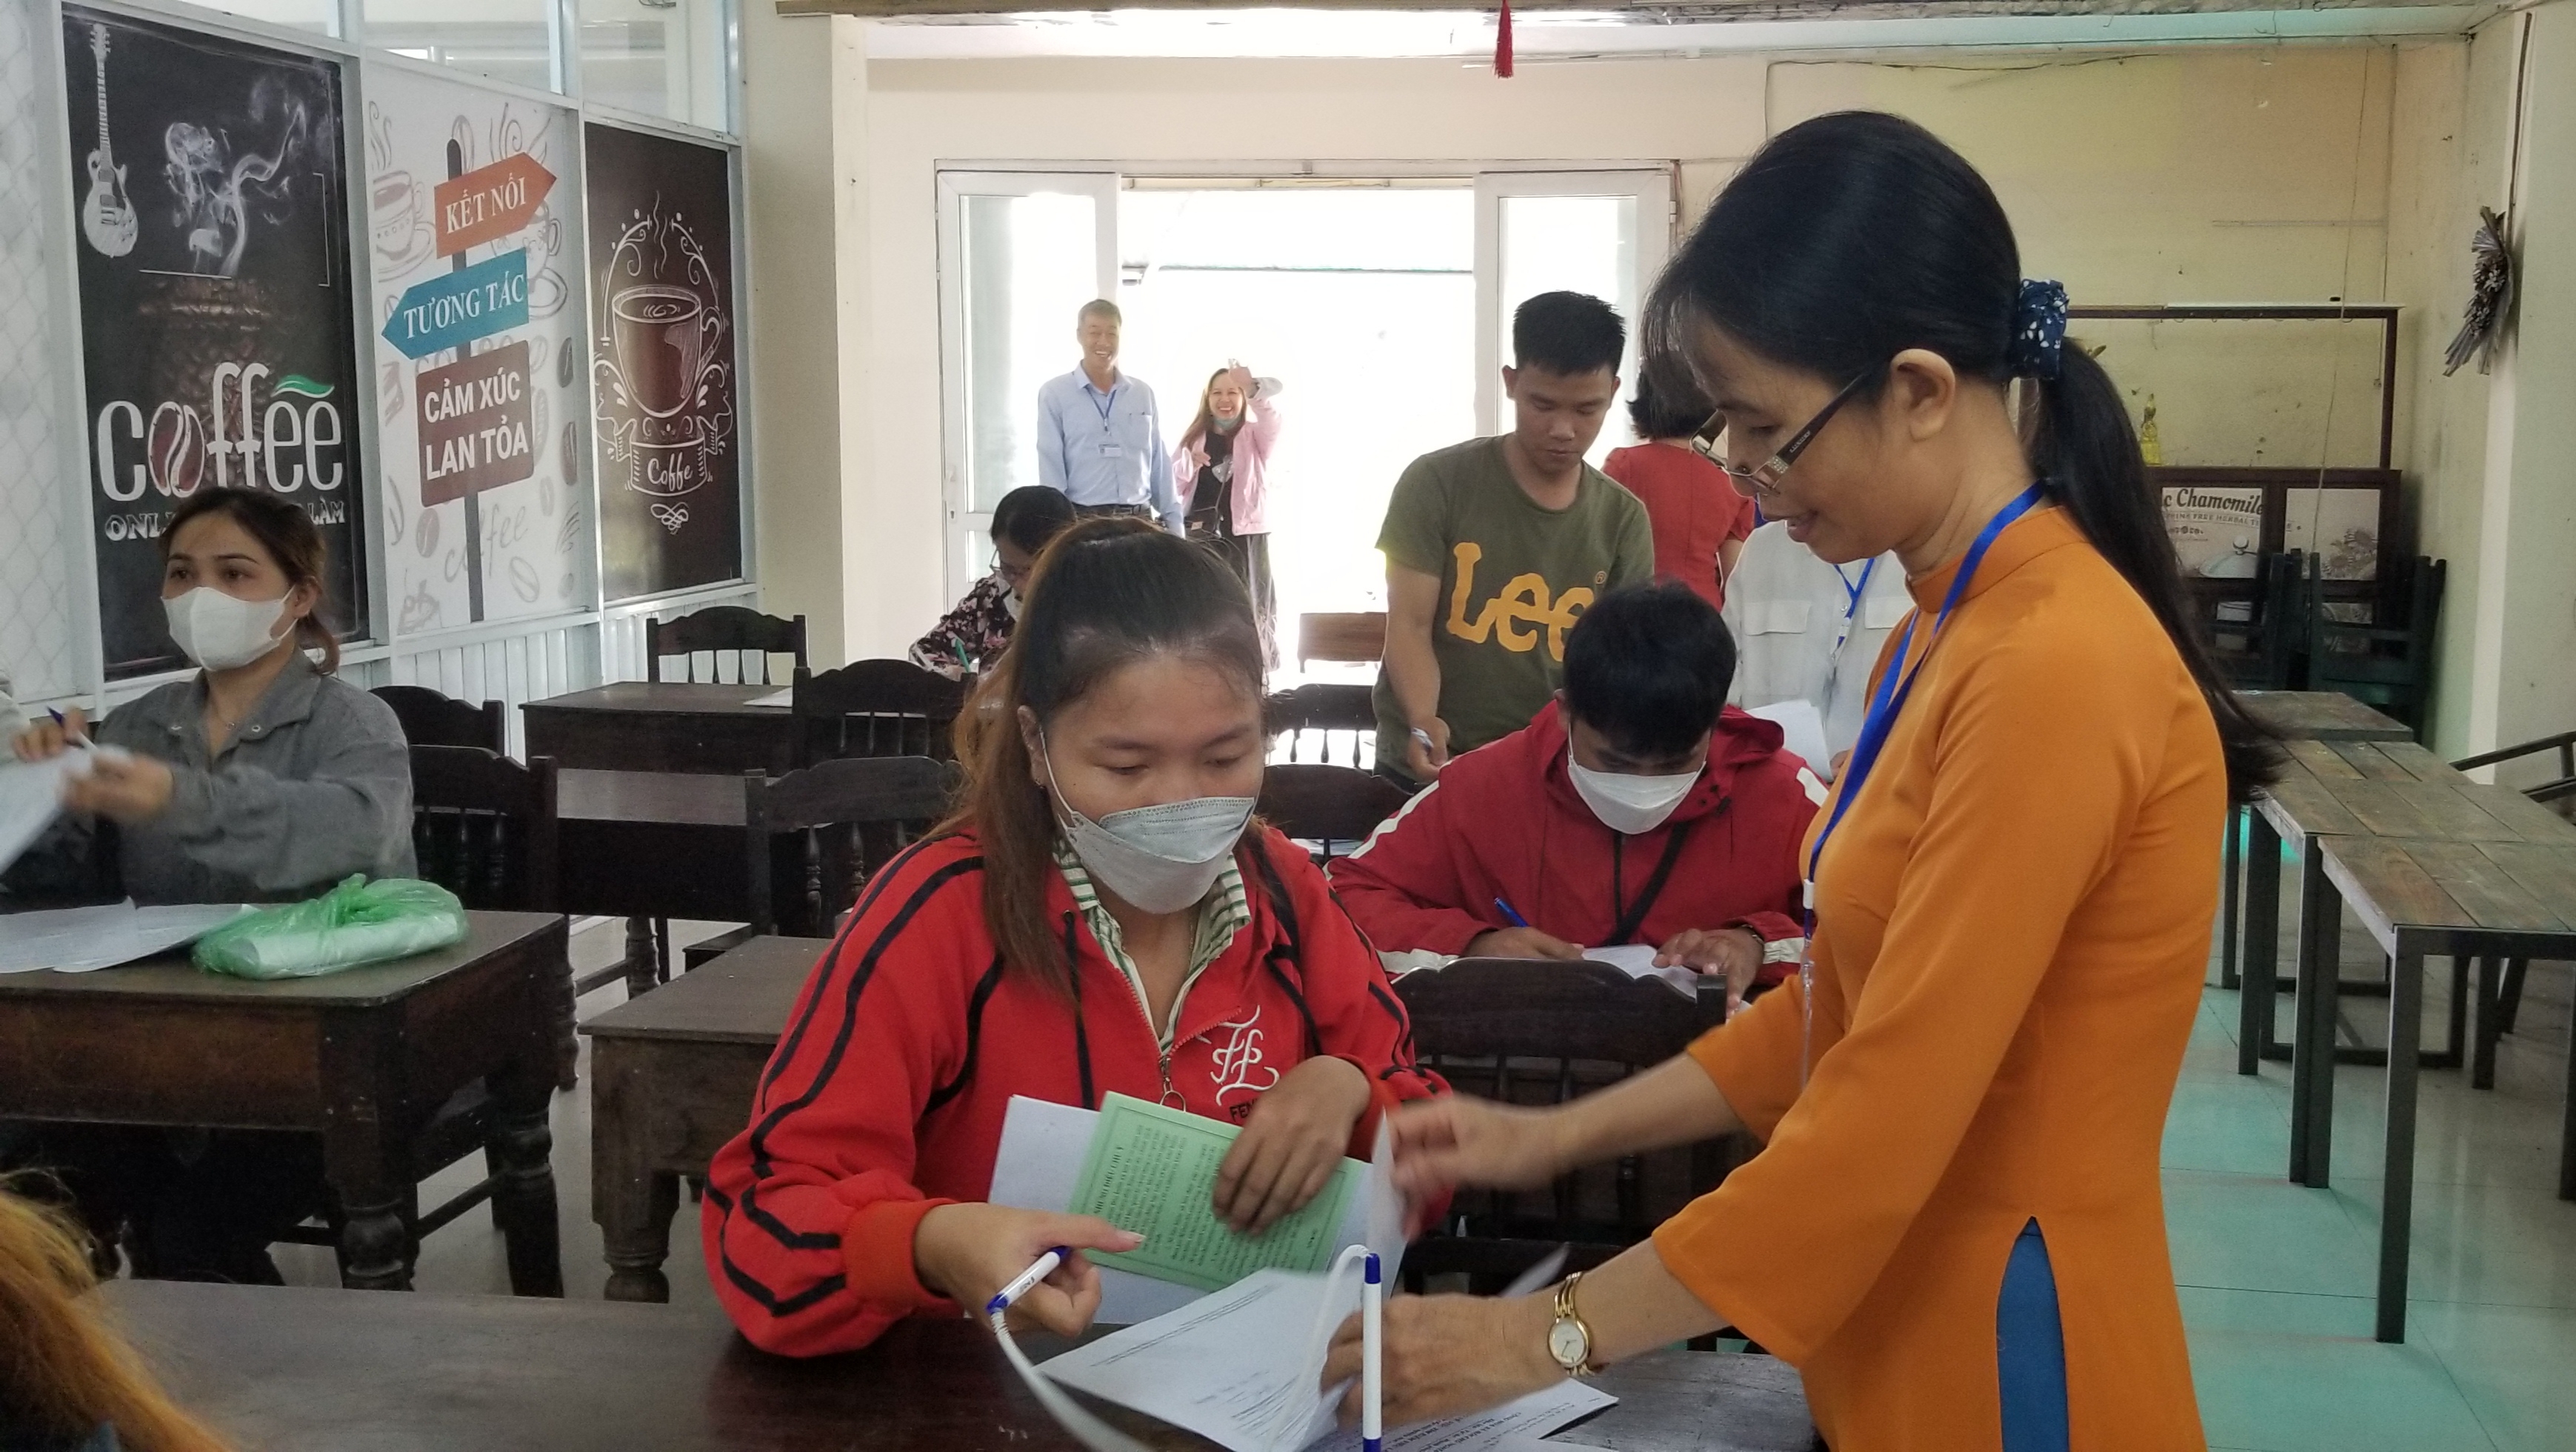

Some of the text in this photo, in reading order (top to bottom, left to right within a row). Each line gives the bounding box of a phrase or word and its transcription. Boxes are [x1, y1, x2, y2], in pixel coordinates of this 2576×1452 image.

[446, 172, 527, 235] KẾT NỐI
[404, 270, 525, 339] TƯƠNG TÁC
[424, 367, 521, 423] CẢM XÚC
[426, 414, 529, 481] LAN TỎA
[647, 451, 693, 492] Coffe
[2176, 488, 2263, 516] Chamomile
[1446, 542, 1595, 662] Lee
